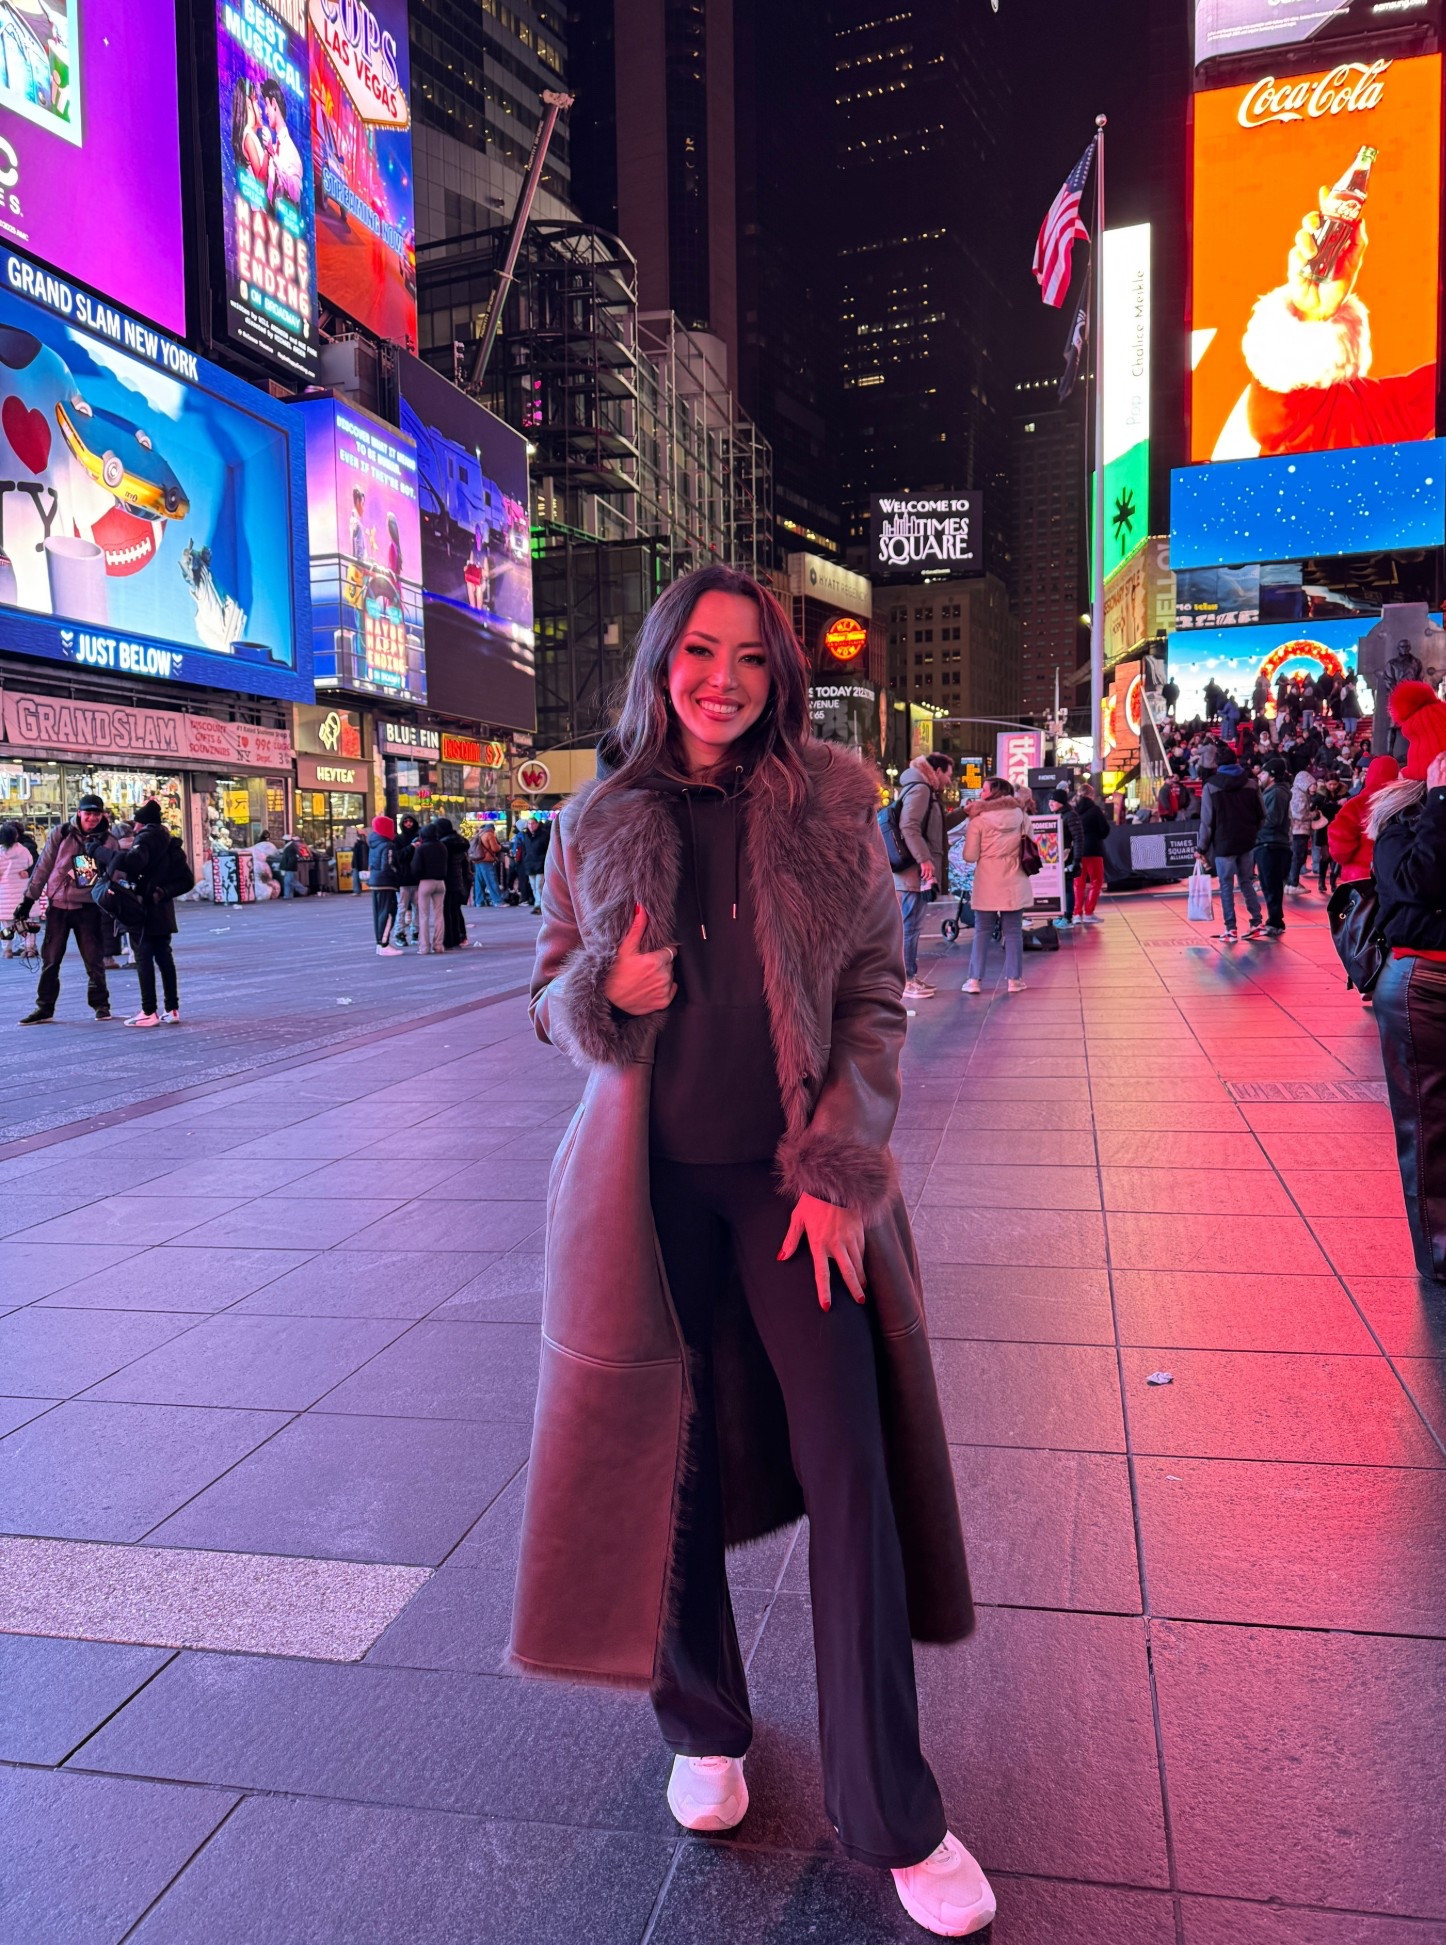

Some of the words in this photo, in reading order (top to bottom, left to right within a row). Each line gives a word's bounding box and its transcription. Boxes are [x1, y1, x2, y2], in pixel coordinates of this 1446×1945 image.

[244, 0, 287, 54] BEST
[225, 4, 305, 98] MUSICAL
[324, 18, 350, 67] LAS
[354, 50, 398, 119] VEGAS
[322, 166, 380, 237] STREAMING
[381, 219, 404, 258] NOW
[237, 196, 308, 268] MAYBE
[238, 225, 309, 291] HAPPY
[240, 250, 311, 318] ENDING
[1133, 269, 1145, 318] Meikle
[7, 256, 73, 313] GRAND
[76, 293, 121, 340] SLAM
[124, 322, 159, 360] NEW
[160, 338, 199, 382] YORK
[265, 297, 301, 330] BROADWAY
[1132, 319, 1145, 377] Chalice
[336, 415, 370, 444] DISCOVER
[339, 449, 359, 469] EVEN
[356, 441, 367, 456] TO
[879, 499, 949, 513] WELCOME
[950, 500, 970, 511] TO
[919, 518, 969, 536] TIMES
[819, 576, 840, 592] HYATT
[366, 616, 404, 644] MAYBE
[75, 633, 117, 665] JUST
[119, 643, 173, 676] BELOW
[366, 633, 405, 661] HAPPY
[367, 650, 407, 677] ENDING
[816, 686, 852, 697] TODAY
[386, 723, 417, 745] BLUE
[420, 730, 439, 748] FIN
[1009, 736, 1035, 788] tkts
[1167, 847, 1195, 855] SQUARE
[1169, 839, 1193, 847] TIMES
[213, 857, 223, 902] CHICAGO
